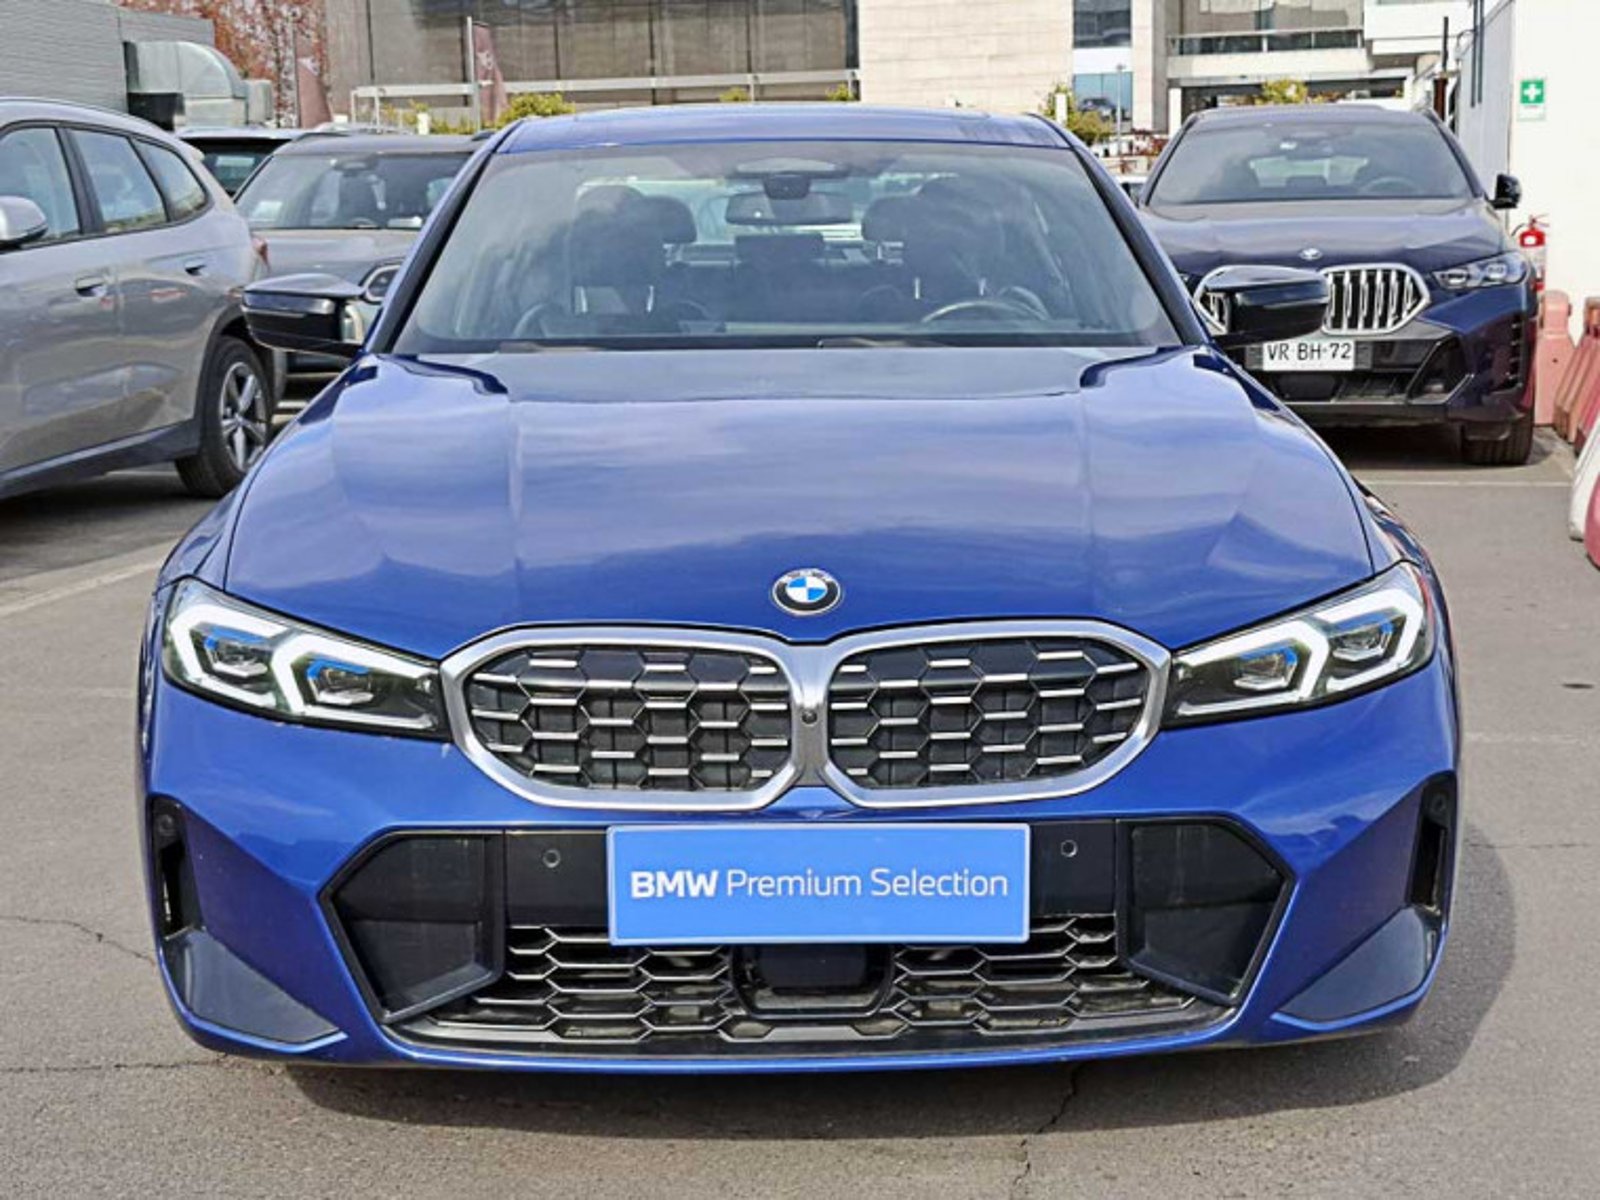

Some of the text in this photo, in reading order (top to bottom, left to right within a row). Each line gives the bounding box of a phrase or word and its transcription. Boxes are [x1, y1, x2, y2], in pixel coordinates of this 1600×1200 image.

[1267, 343, 1289, 361] VR
[630, 868, 1009, 898] BMW Premium Selection
